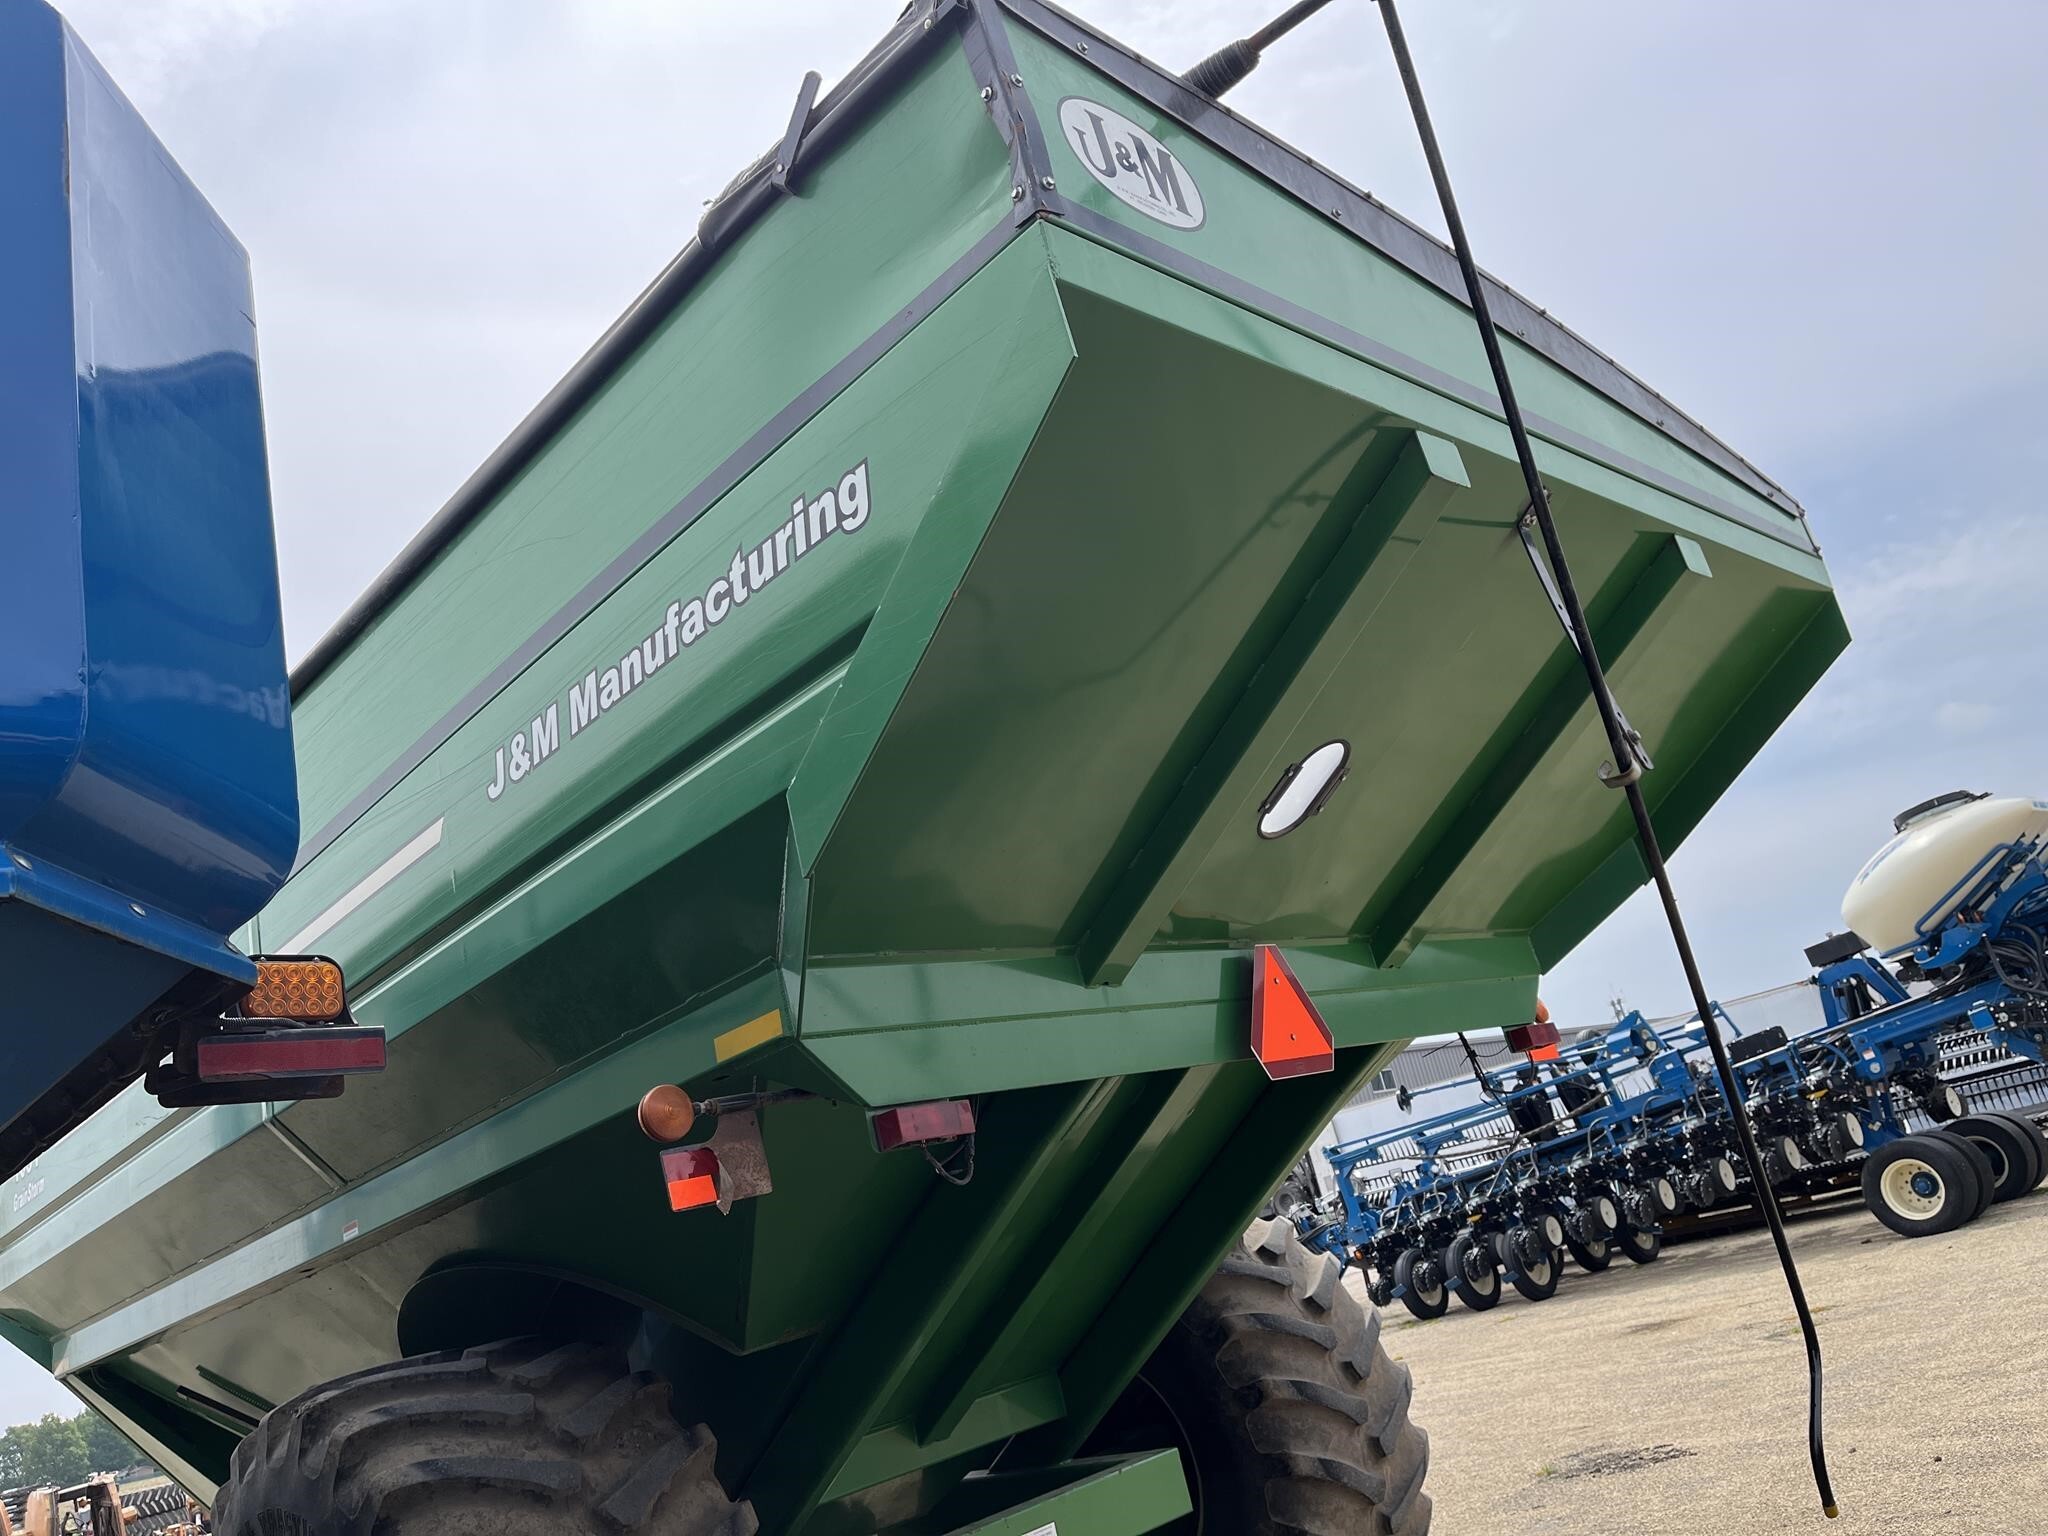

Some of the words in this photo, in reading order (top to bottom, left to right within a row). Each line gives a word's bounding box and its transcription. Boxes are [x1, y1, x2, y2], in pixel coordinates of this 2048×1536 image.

[1072, 108, 1193, 218] J&M
[487, 703, 560, 801] J&M
[568, 457, 871, 740] Manufacturing
